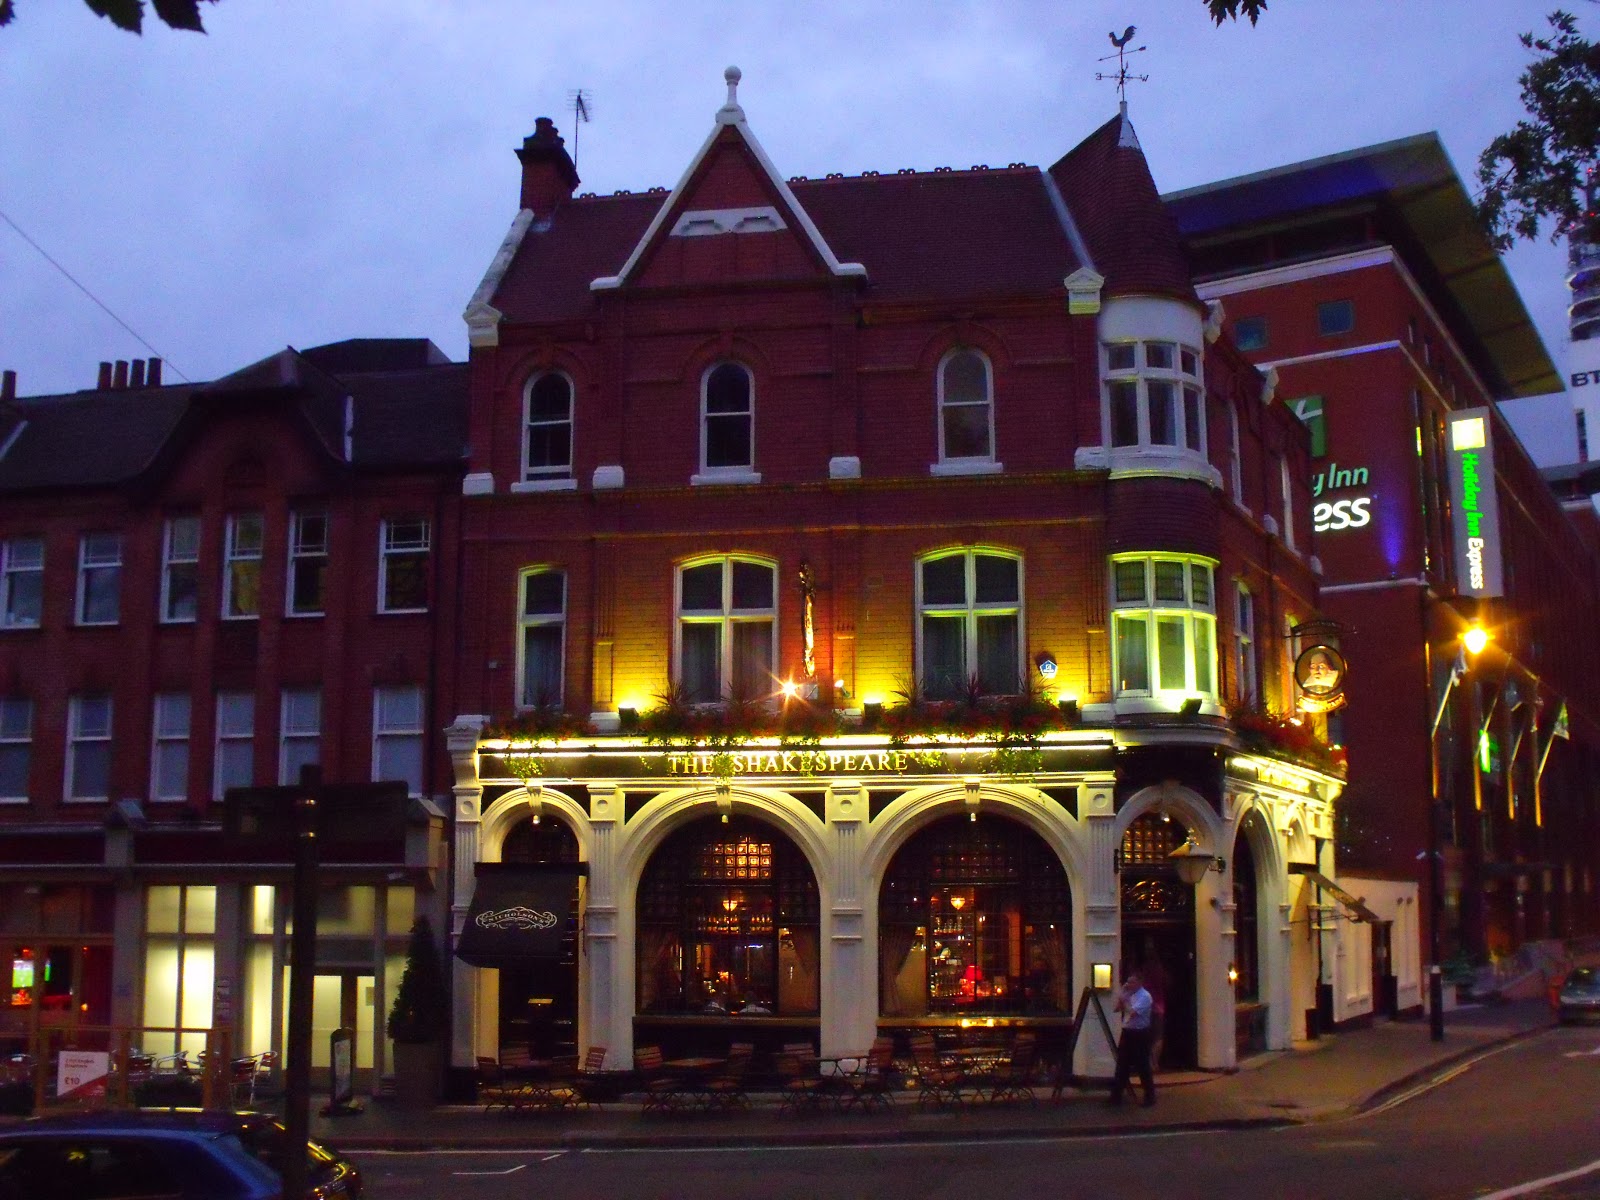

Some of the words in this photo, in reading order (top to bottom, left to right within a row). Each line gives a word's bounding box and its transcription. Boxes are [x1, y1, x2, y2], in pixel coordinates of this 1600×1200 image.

[1571, 370, 1600, 387] BT
[1328, 463, 1369, 488] Inn
[1462, 453, 1481, 510] Holiday
[1466, 512, 1484, 537] Inn
[1466, 538, 1484, 590] Express
[667, 756, 715, 774] THE
[732, 753, 908, 773] SHAKESPEARE
